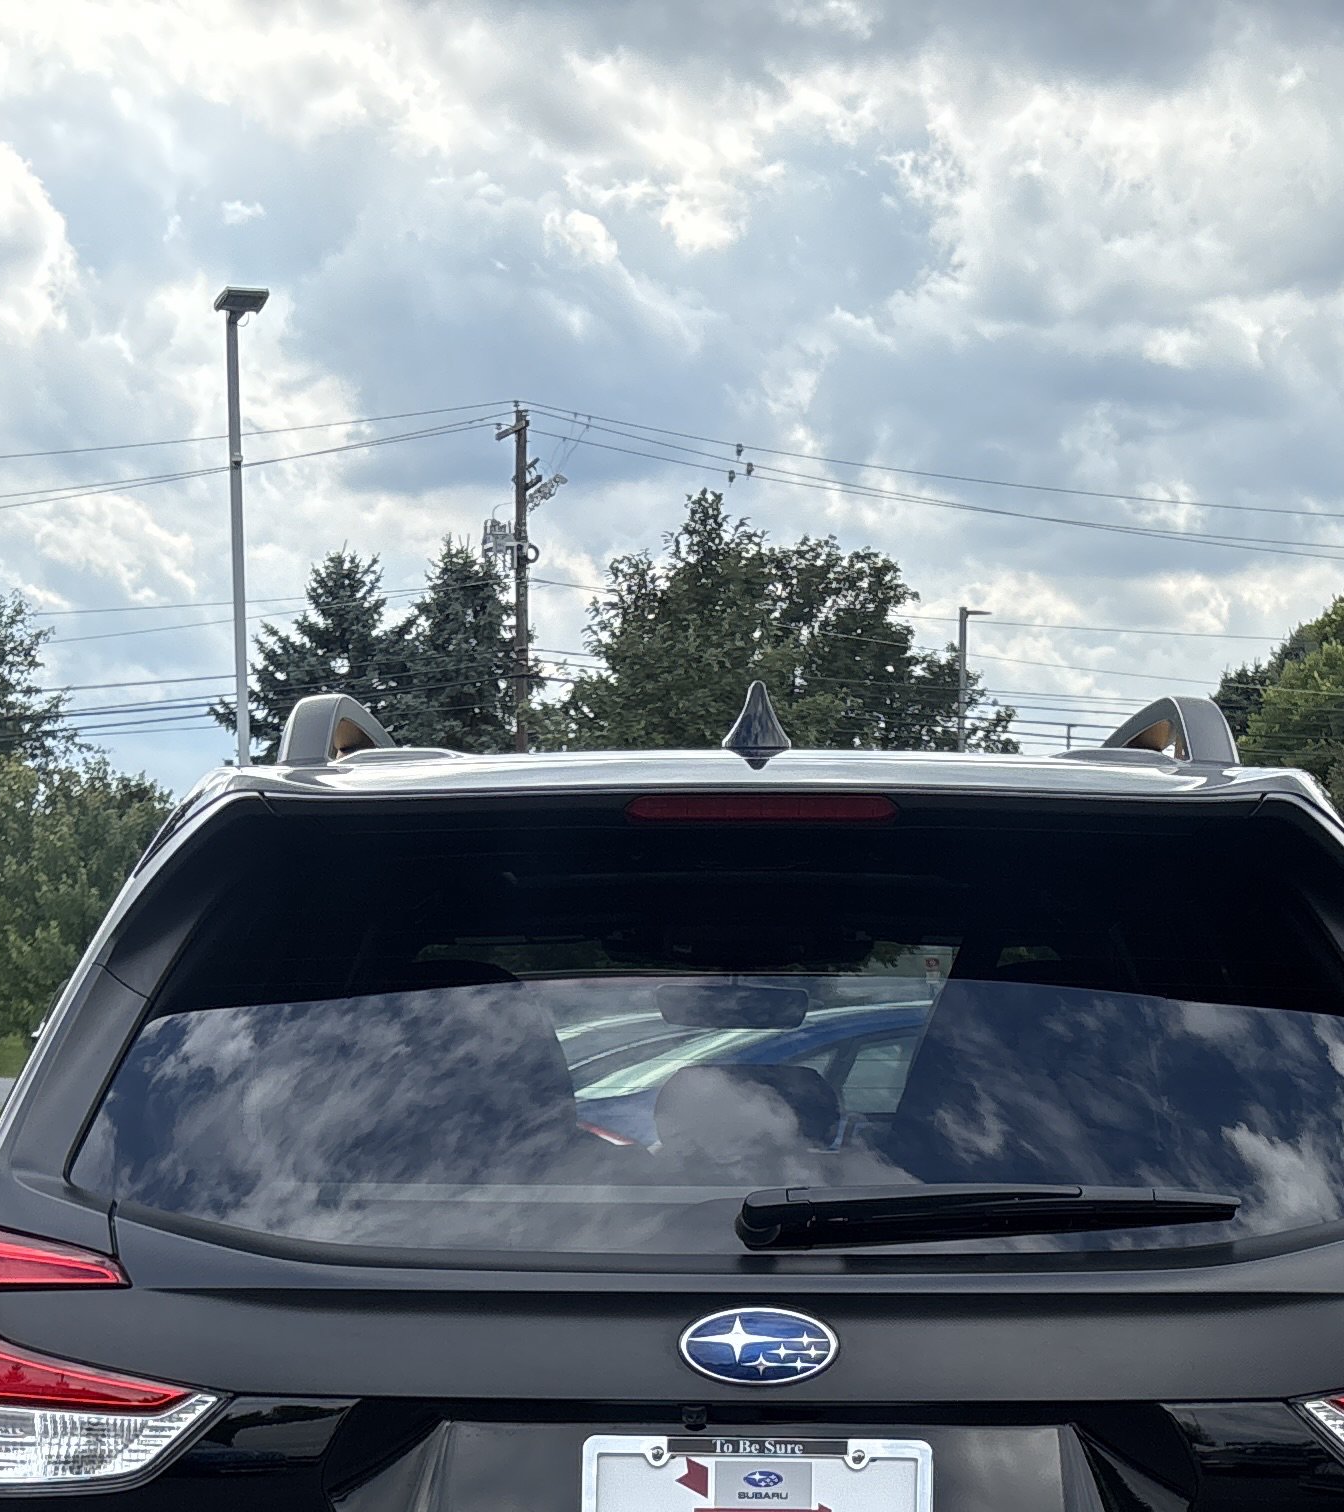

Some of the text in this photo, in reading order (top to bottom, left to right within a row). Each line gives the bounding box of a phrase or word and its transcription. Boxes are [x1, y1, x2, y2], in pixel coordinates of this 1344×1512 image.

[711, 1440, 804, 1454] To Be Sure
[737, 1491, 789, 1500] SUBARU
